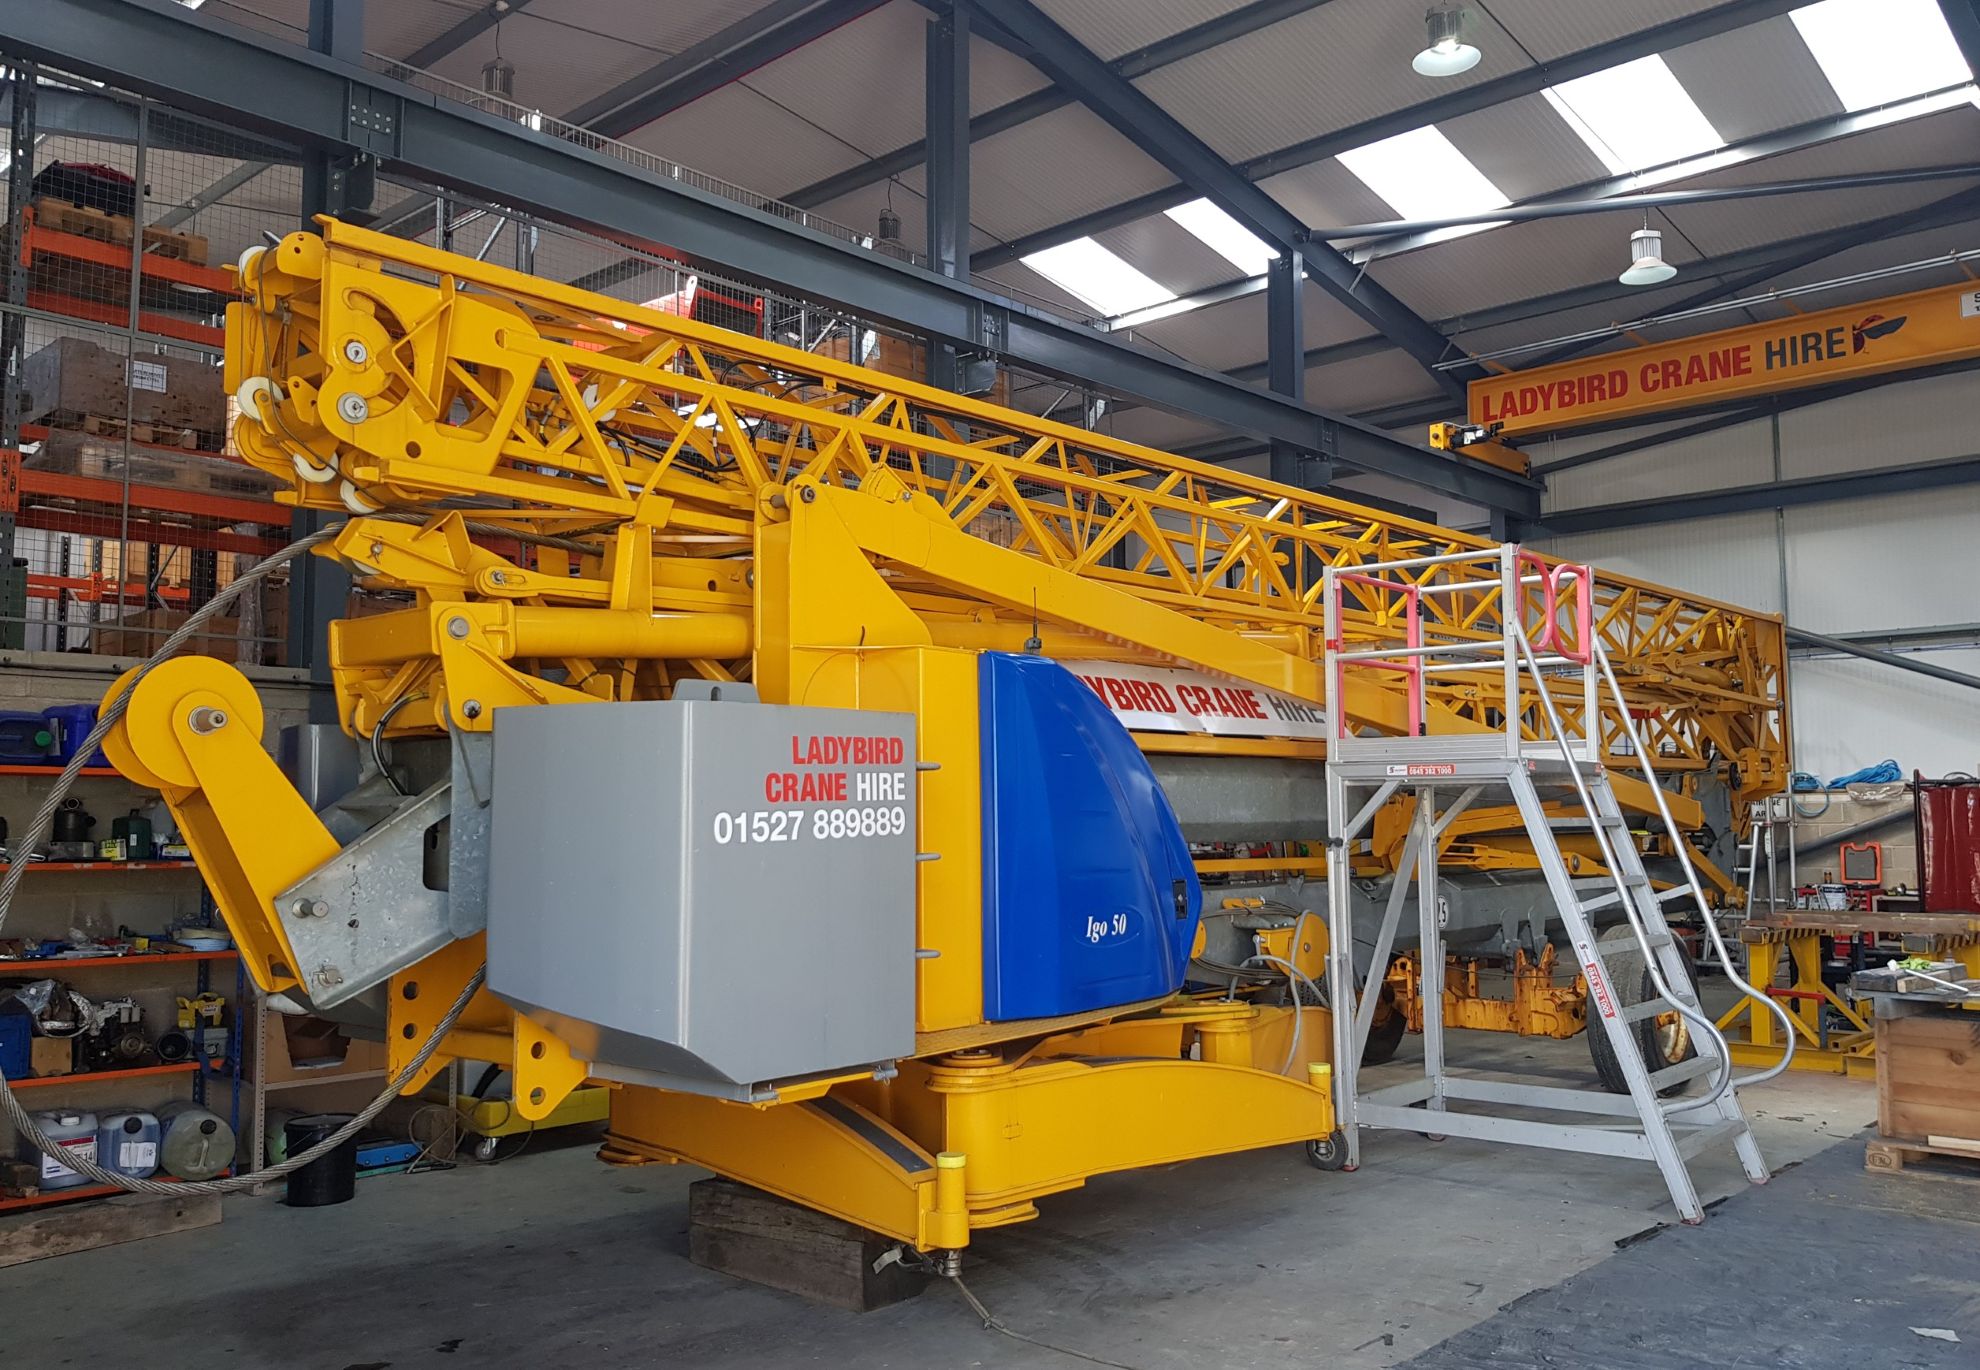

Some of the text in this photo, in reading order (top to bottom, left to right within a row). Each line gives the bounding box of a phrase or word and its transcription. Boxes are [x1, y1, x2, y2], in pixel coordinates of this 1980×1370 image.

[1482, 326, 1846, 423] LADYBIRD CRANE HIRE
[1074, 675, 1178, 714] YBIRD
[1176, 684, 1269, 721] CRANE
[792, 735, 905, 765] LADYBIRD
[765, 772, 906, 803] CRANE HIRE
[713, 806, 906, 845] 01527 889889
[1085, 913, 1127, 943] Igo 50
